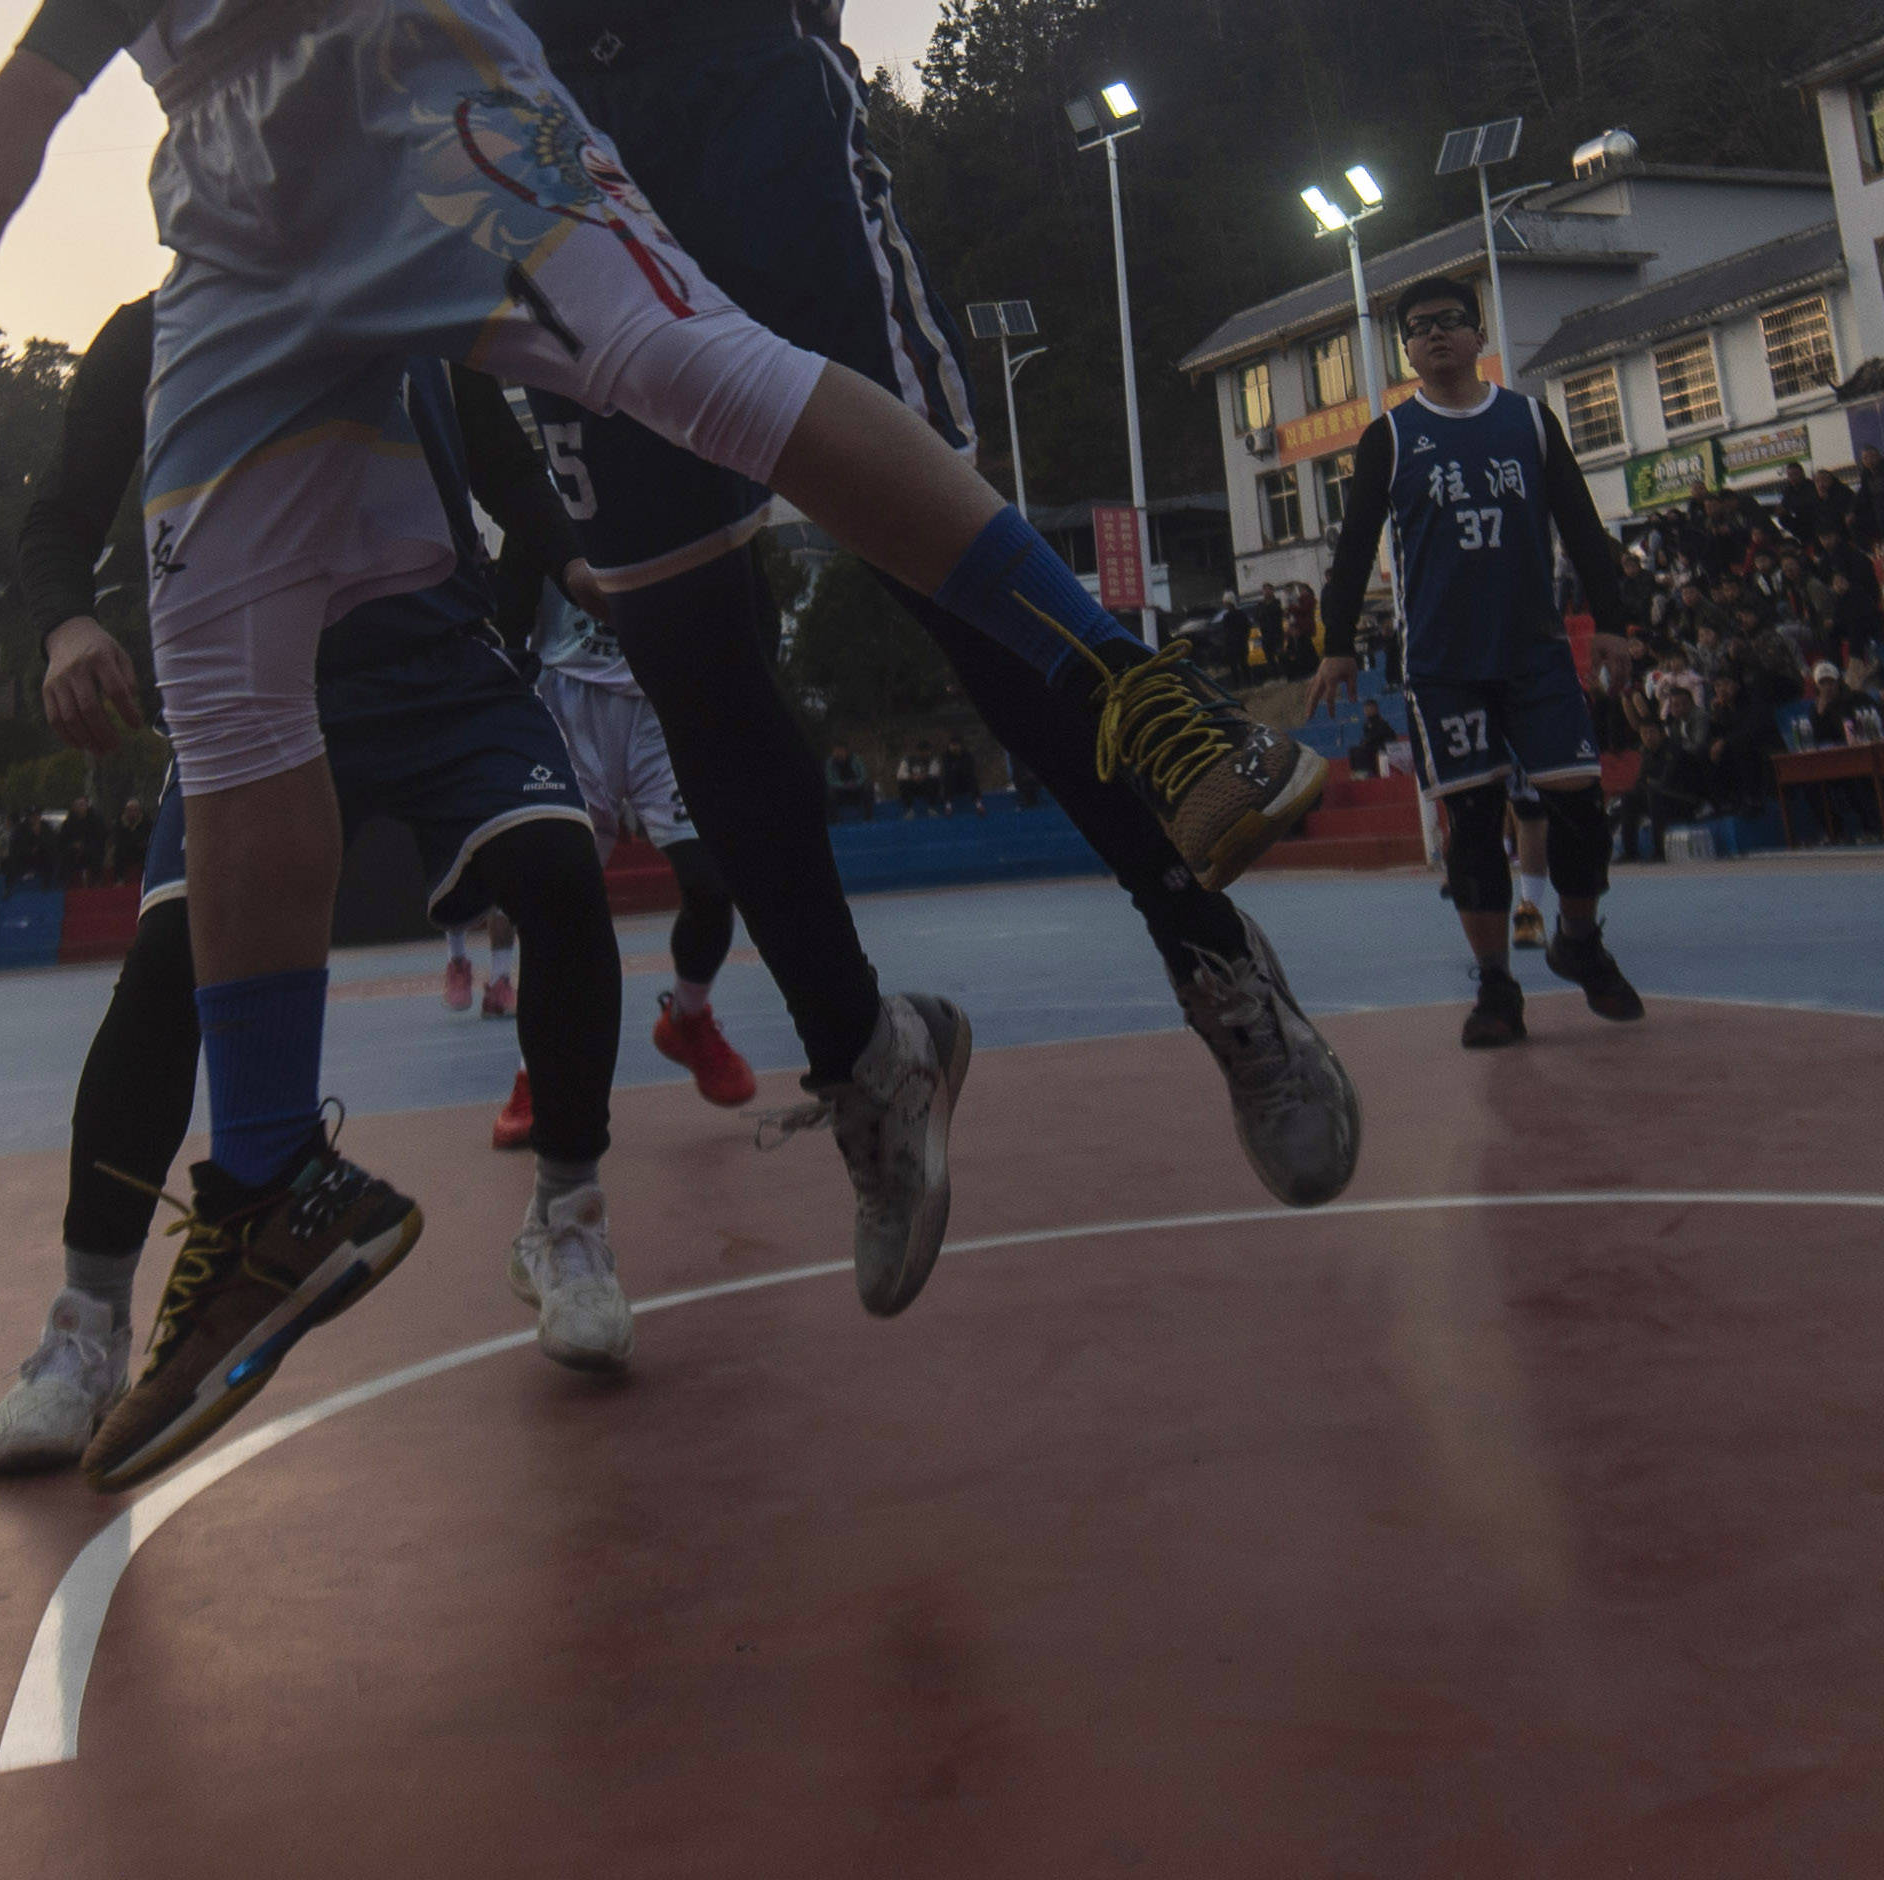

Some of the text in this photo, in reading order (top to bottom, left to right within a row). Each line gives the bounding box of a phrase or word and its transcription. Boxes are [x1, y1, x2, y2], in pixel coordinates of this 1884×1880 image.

[541, 421, 599, 520] 5
[1428, 456, 1526, 508] 往洞
[1653, 453, 1704, 480] 中国邮政
[1456, 507, 1503, 551] 37
[1440, 709, 1489, 758] 37
